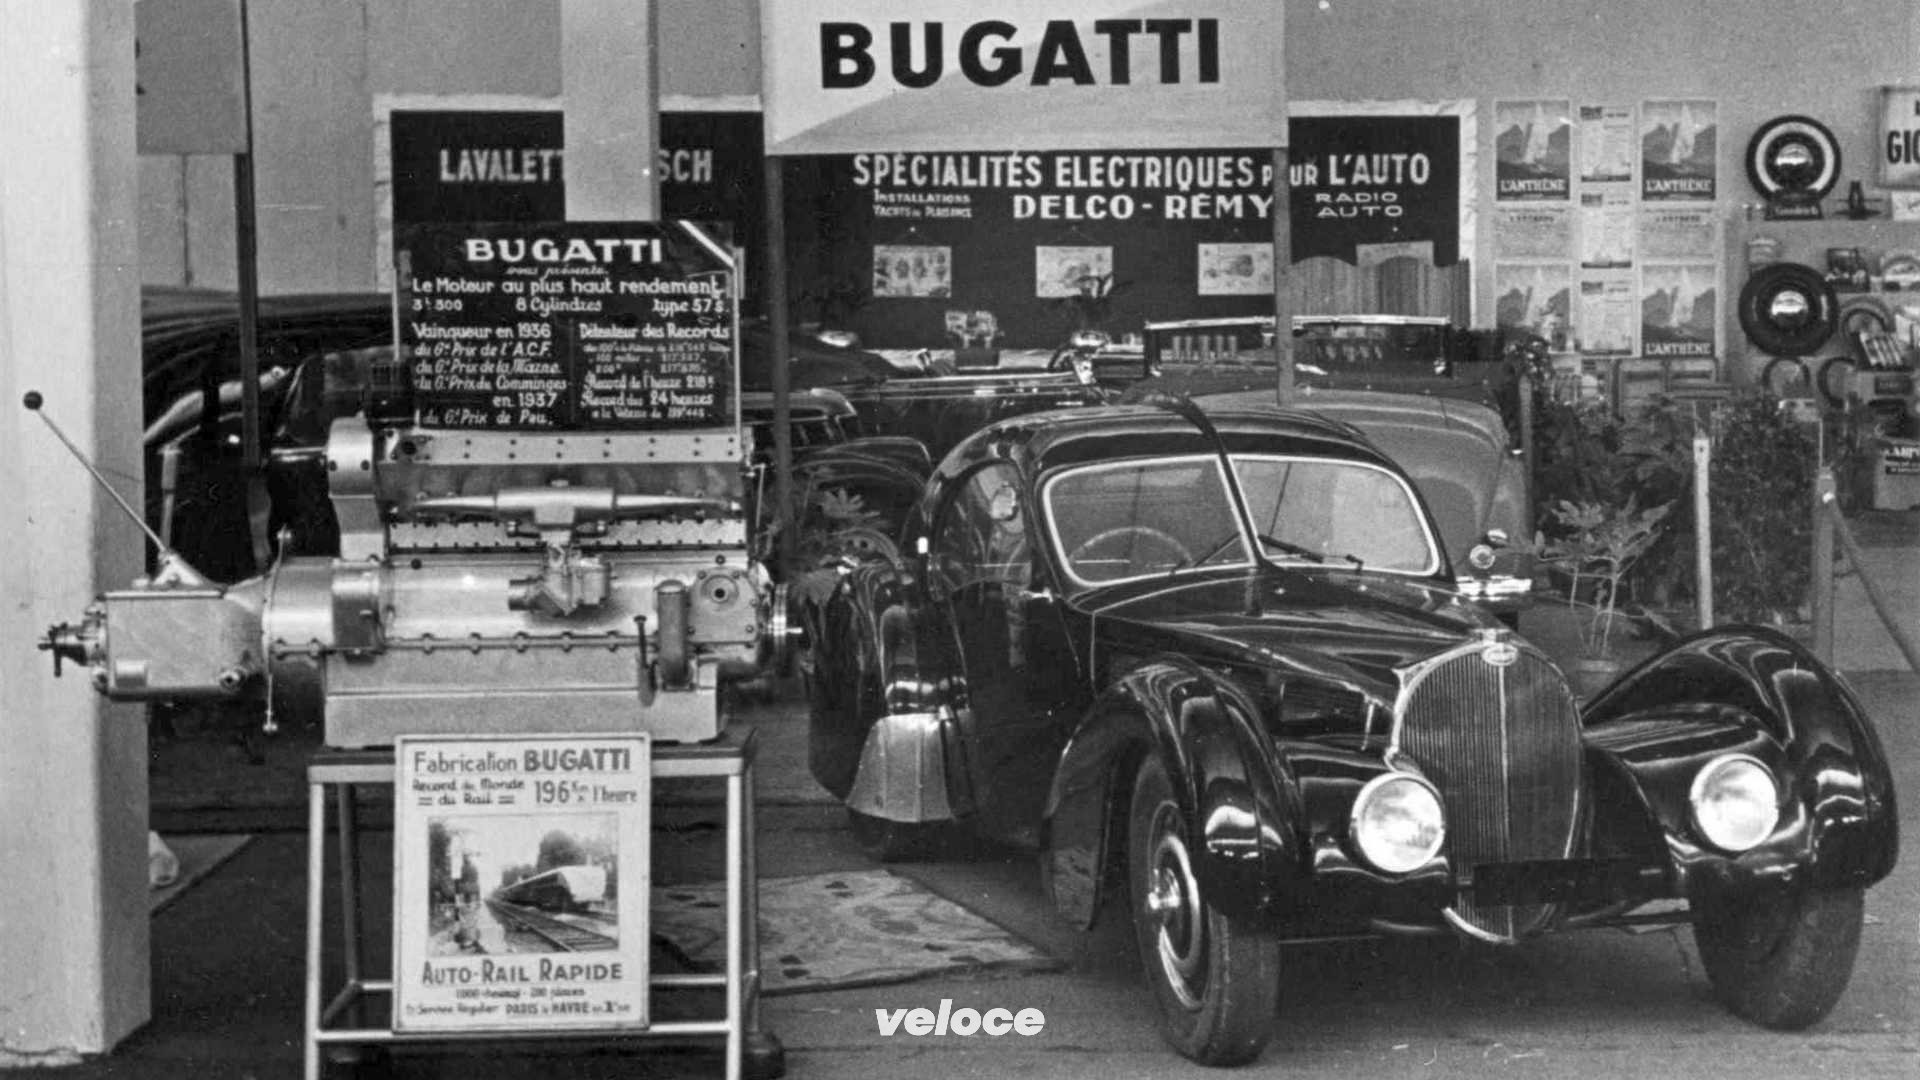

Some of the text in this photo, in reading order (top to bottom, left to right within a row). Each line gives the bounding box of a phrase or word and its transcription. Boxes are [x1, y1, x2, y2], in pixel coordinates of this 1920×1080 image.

[820, 18, 1220, 89] BUGATTI
[1055, 155, 1254, 191] ELECTRIQUES
[1262, 164, 1318, 187] PUR
[1328, 152, 1430, 186] L'AUTO
[1315, 192, 1398, 203] RADIO
[1317, 205, 1403, 217] AUTO
[466, 238, 662, 263] BUGATTI
[412, 277, 432, 293] Le
[436, 277, 495, 293] Moteur
[501, 280, 525, 293] au
[530, 279, 564, 297] plus
[571, 277, 614, 294] haut
[515, 296, 527, 312] 8
[530, 296, 602, 318] Cylindres
[411, 321, 551, 343] Vainqueur en 1936
[641, 322, 665, 339] des
[666, 321, 730, 340] Records
[480, 343, 499, 357] de
[496, 375, 568, 395] Comminges
[518, 391, 558, 408] 1937
[651, 389, 669, 406] 24
[460, 408, 488, 425] Prix
[496, 410, 512, 424] de
[414, 748, 630, 774] Fabrication BUGATTI
[412, 778, 457, 791] Record
[480, 778, 525, 790] Monde
[535, 780, 569, 804] 196
[437, 794, 457, 805] du
[539, 957, 624, 981] RAPIDE
